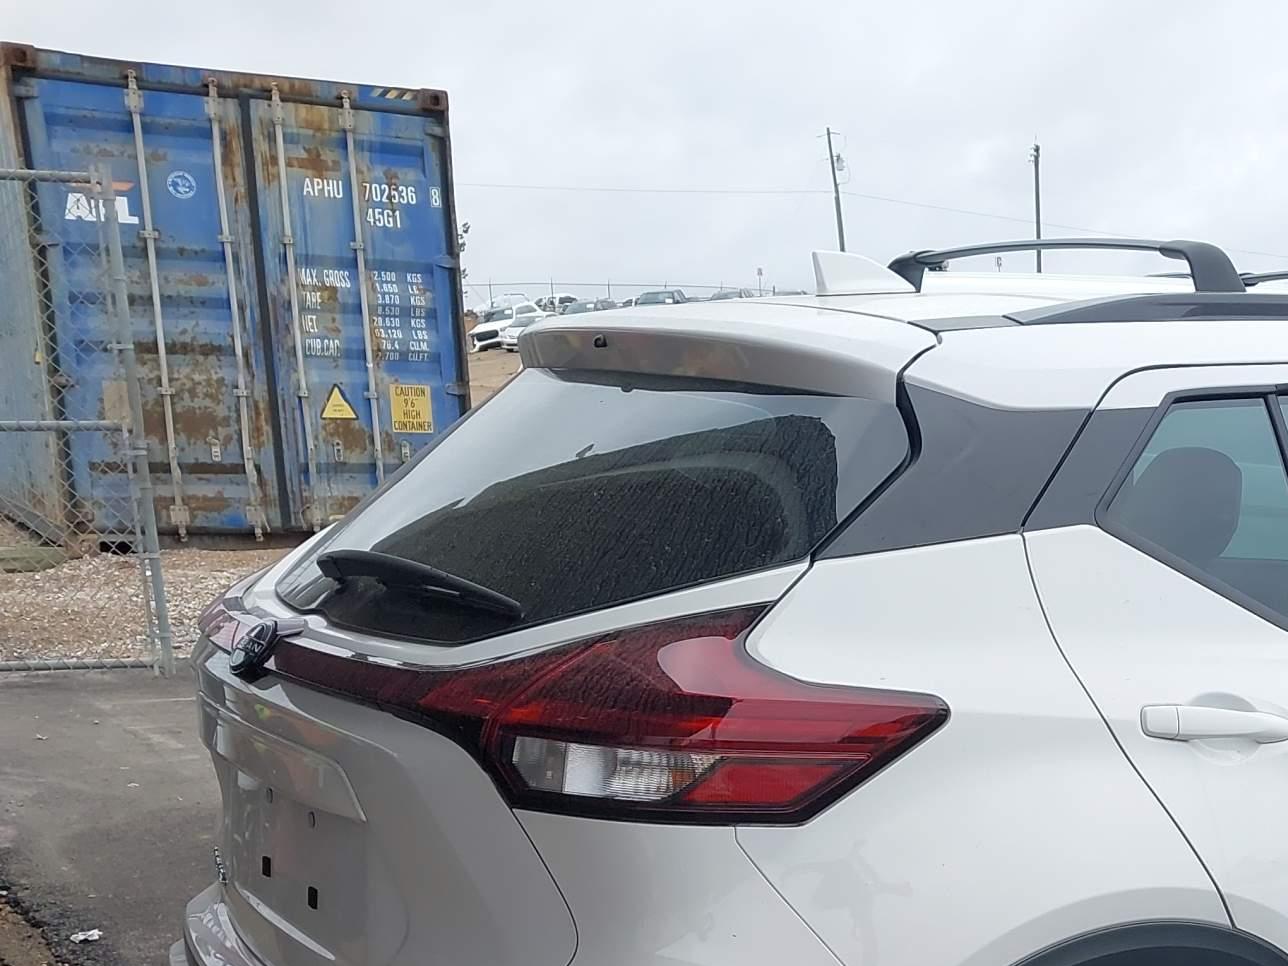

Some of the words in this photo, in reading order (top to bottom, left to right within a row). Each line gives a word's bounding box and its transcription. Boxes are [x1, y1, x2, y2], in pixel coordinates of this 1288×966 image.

[303, 177, 343, 199] APHU
[430, 187, 441, 207] 8
[366, 208, 402, 229] 45G1
[323, 269, 351, 288] GROSS
[406, 273, 422, 283] KGS
[302, 291, 322, 309] TARE
[410, 296, 426, 306] KGS
[411, 307, 426, 317] LBS
[301, 314, 319, 333] NET
[411, 318, 426, 328] KGS
[411, 329, 428, 339] LBS
[394, 386, 426, 398] CAUTION
[402, 409, 421, 420] HIGH
[393, 421, 432, 432] CONTAINER
